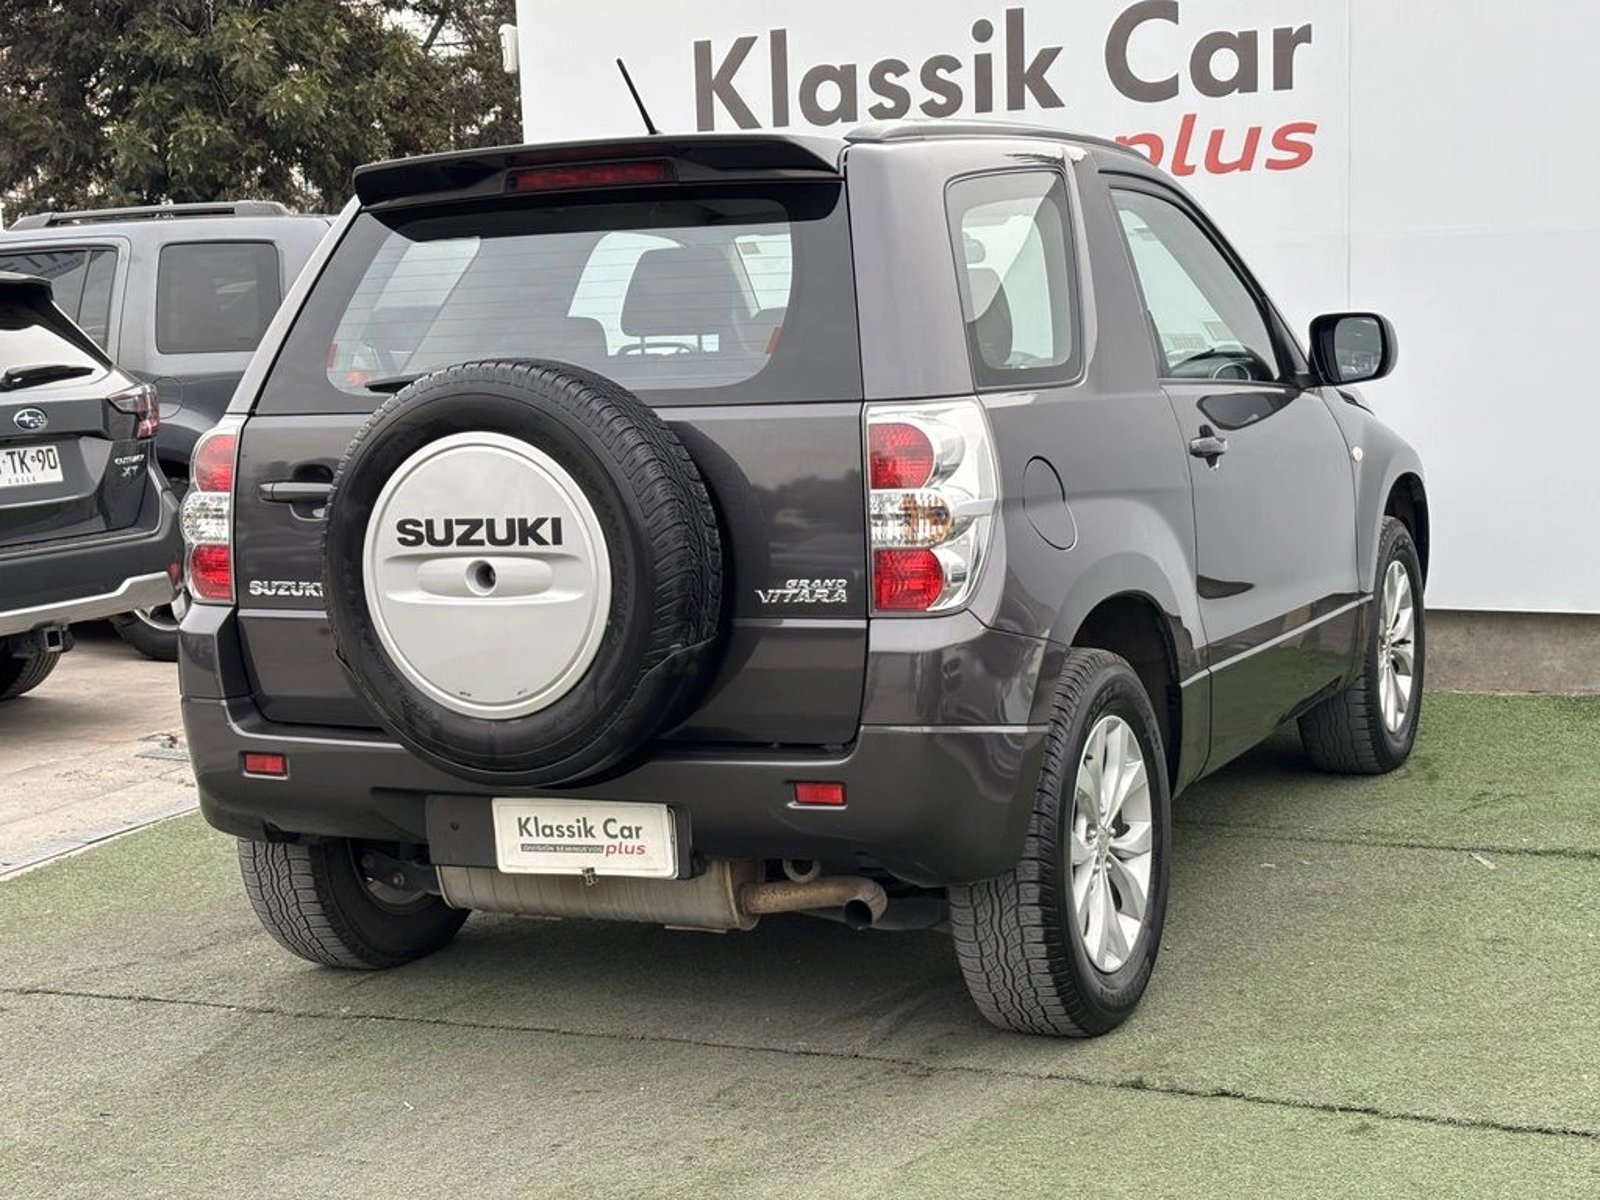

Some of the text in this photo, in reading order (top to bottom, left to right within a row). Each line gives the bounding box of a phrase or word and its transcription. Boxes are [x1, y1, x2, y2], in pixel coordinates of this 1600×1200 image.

[693, 0, 1312, 132] Klassik Car
[396, 516, 562, 547] SUZUKI
[785, 579, 848, 589] GRAND
[754, 588, 848, 603] VITARA
[517, 816, 643, 840] Klassik Car
[604, 841, 646, 857] plus
